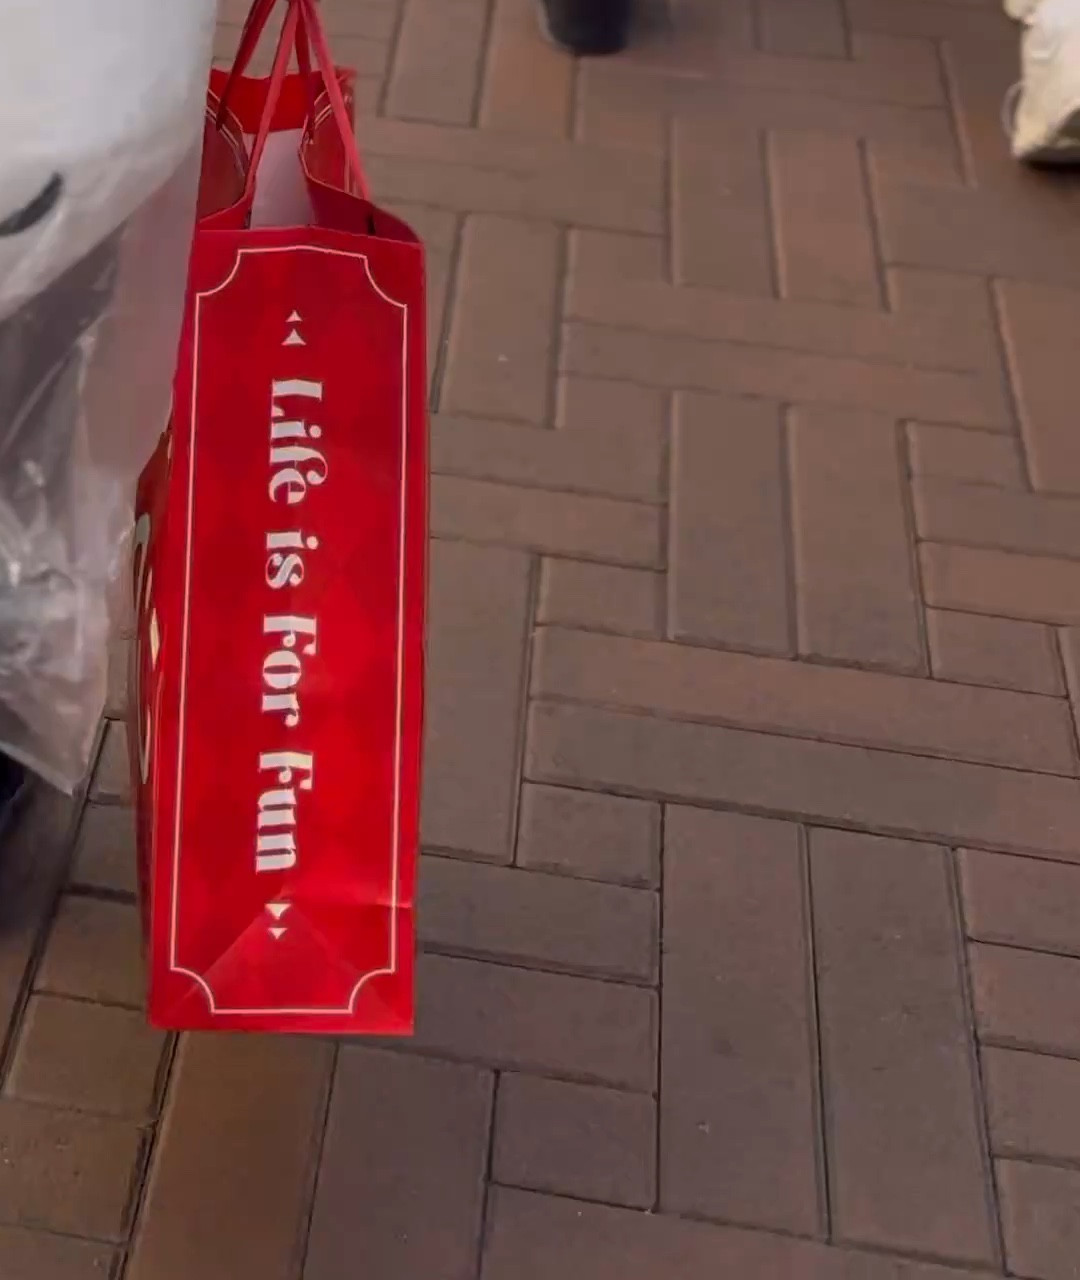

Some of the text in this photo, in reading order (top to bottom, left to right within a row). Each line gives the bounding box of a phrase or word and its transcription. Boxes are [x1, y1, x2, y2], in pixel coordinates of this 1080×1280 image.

[255, 378, 327, 872] Life is For Fun
